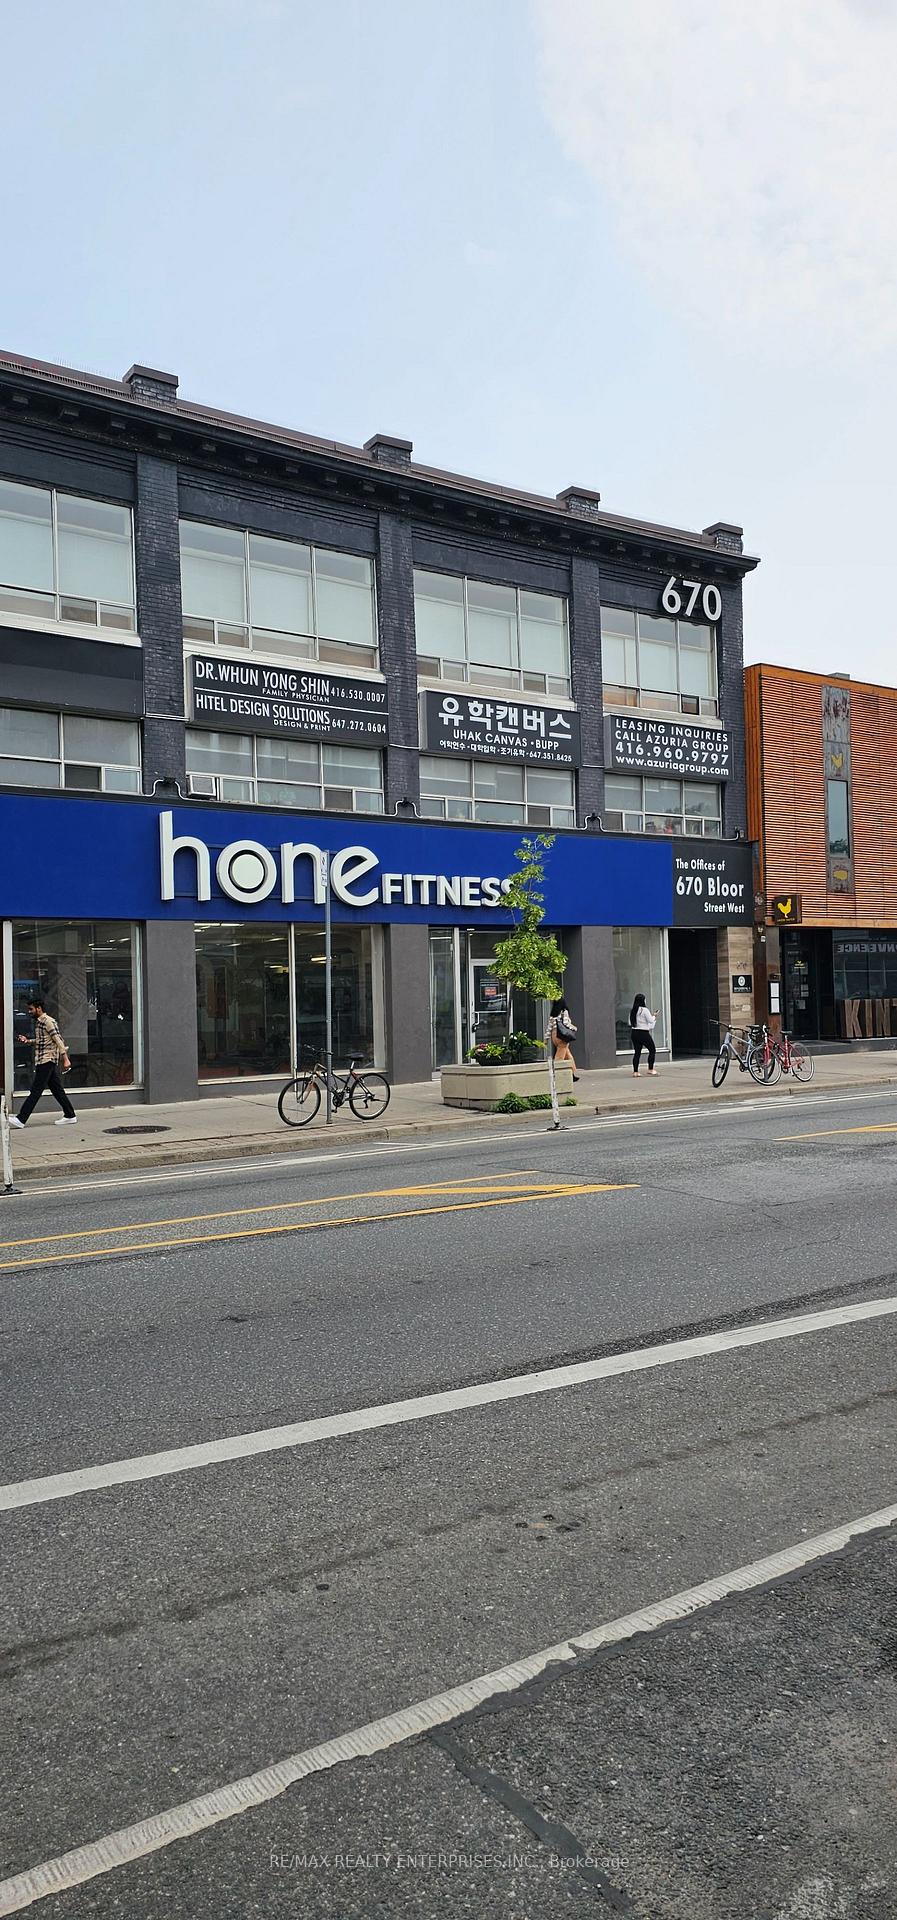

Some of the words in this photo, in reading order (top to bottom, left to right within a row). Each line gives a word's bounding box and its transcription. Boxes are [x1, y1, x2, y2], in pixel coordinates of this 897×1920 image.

[662, 576, 722, 620] 670
[262, 688, 288, 698] FAMILY
[292, 692, 330, 702] PHYSICIAN
[263, 670, 297, 690] YONG
[300, 676, 330, 696] SHIN
[330, 687, 386, 702] 416.530.0007
[196, 694, 227, 712] HITEL
[230, 698, 270, 717] DESIGN
[272, 704, 330, 724] SOLUTIONS
[332, 718, 386, 734] 647.272.0604
[438, 697, 572, 740] 유학캔버스
[274, 720, 302, 728] DESIGN
[310, 724, 330, 732] PRINT
[616, 718, 666, 734] LEASING
[671, 726, 728, 742] INQUIRIES
[453, 729, 481, 742] UHAK
[485, 733, 527, 747] CANVAS
[536, 740, 559, 750] BUPP
[615, 730, 641, 742] CALL
[646, 734, 688, 748] AZURIA
[692, 740, 728, 752] GROUP
[616, 742, 728, 765] 416.960.9797
[616, 756, 729, 775] www.azuriagroup.com
[160, 810, 380, 907] hone
[676, 858, 688, 869] The
[690, 859, 716, 871] Offices
[718, 860, 725, 871] of
[676, 876, 702, 896] 670
[708, 876, 744, 896] Bloor
[704, 902, 725, 912] Street
[727, 902, 744, 913] West
